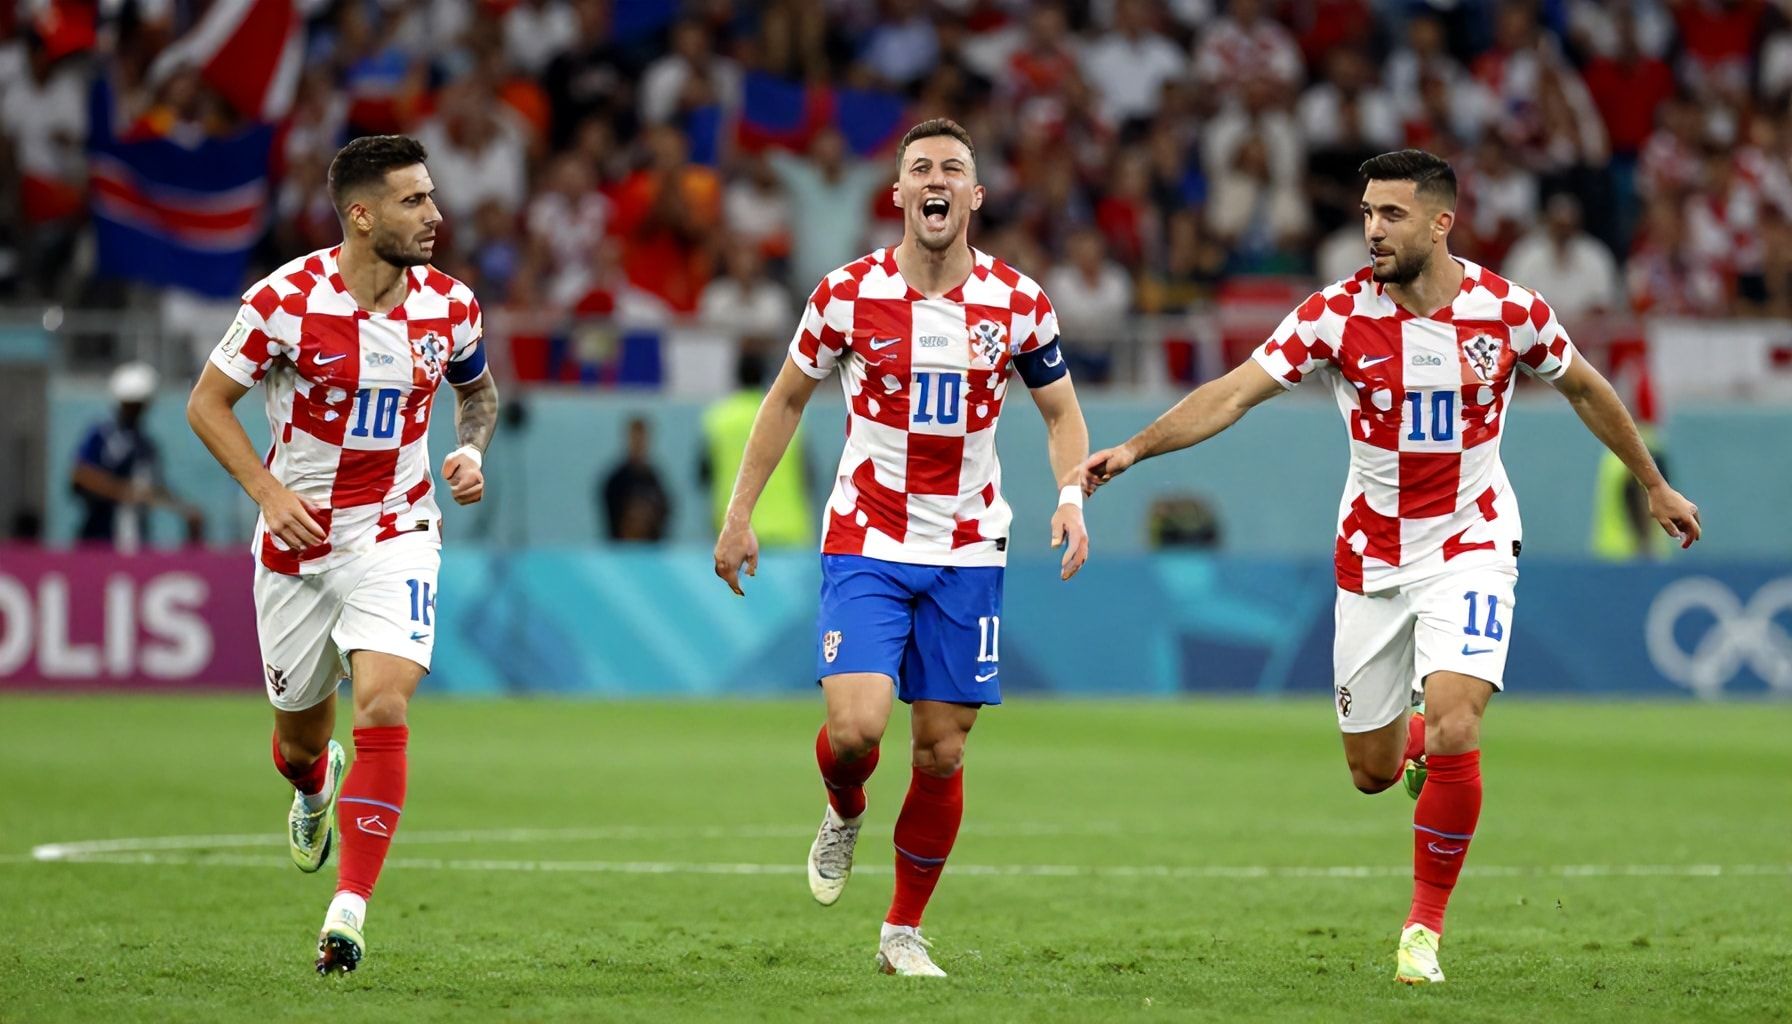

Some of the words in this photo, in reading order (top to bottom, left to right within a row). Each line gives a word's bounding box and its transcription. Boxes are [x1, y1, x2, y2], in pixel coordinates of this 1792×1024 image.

[351, 388, 401, 438] 10
[912, 372, 961, 425] 10
[1406, 390, 1455, 441] 10
